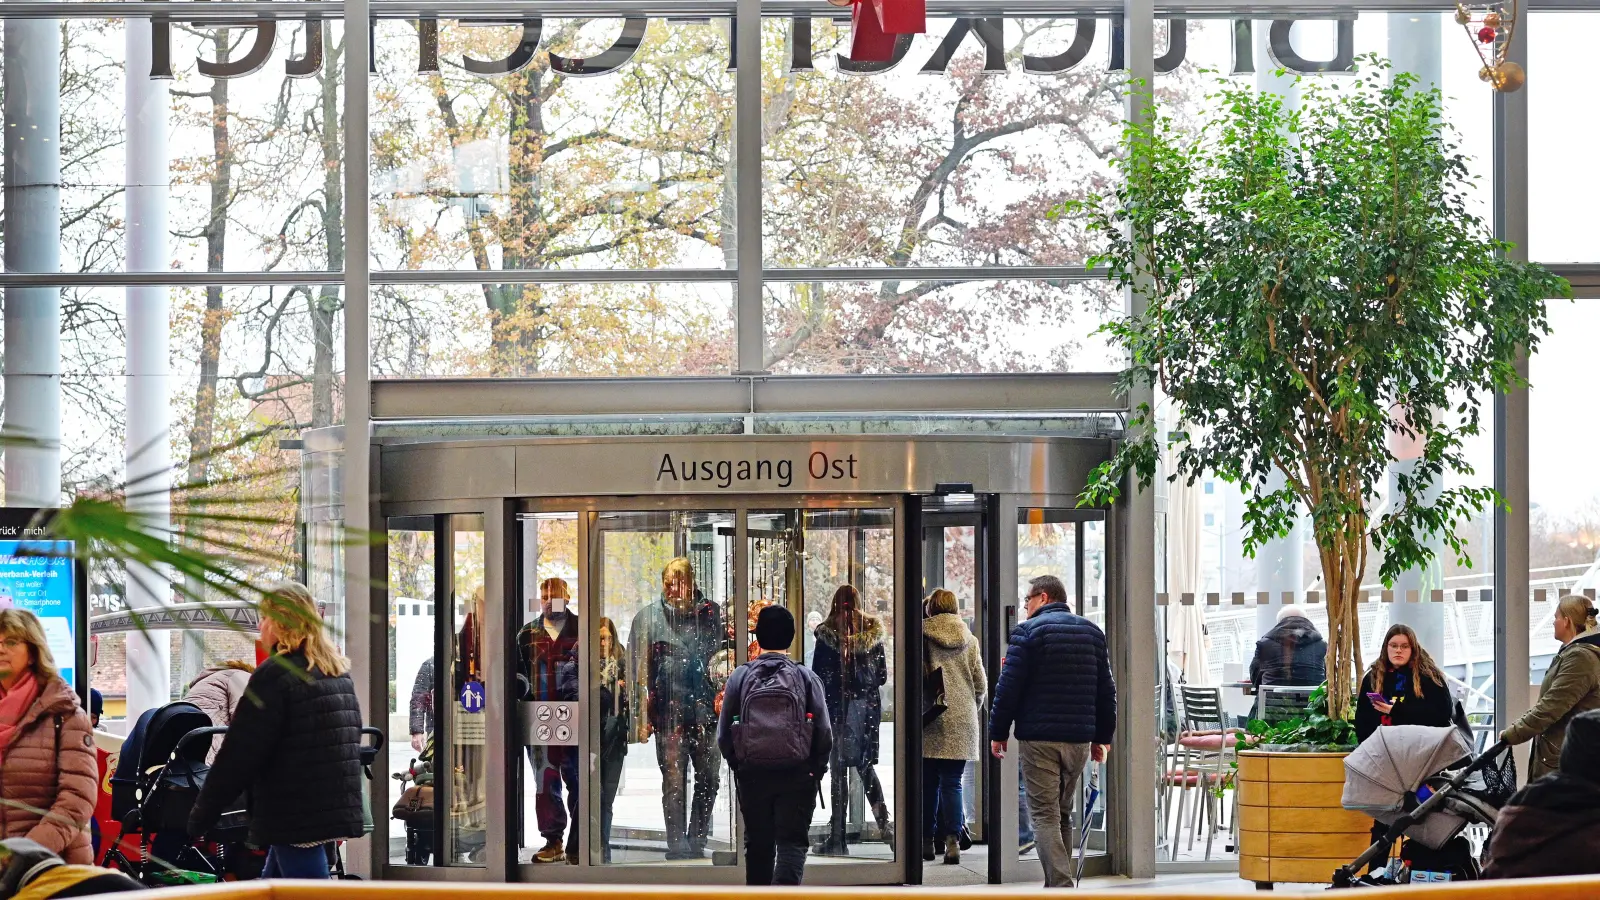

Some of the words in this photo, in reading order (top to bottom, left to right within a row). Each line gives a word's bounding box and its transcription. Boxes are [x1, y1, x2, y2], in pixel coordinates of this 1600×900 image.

[656, 453, 792, 488] Ausgang
[808, 451, 858, 480] Ost
[23, 526, 46, 536] mich!
[24, 599, 61, 607] Smartphone
